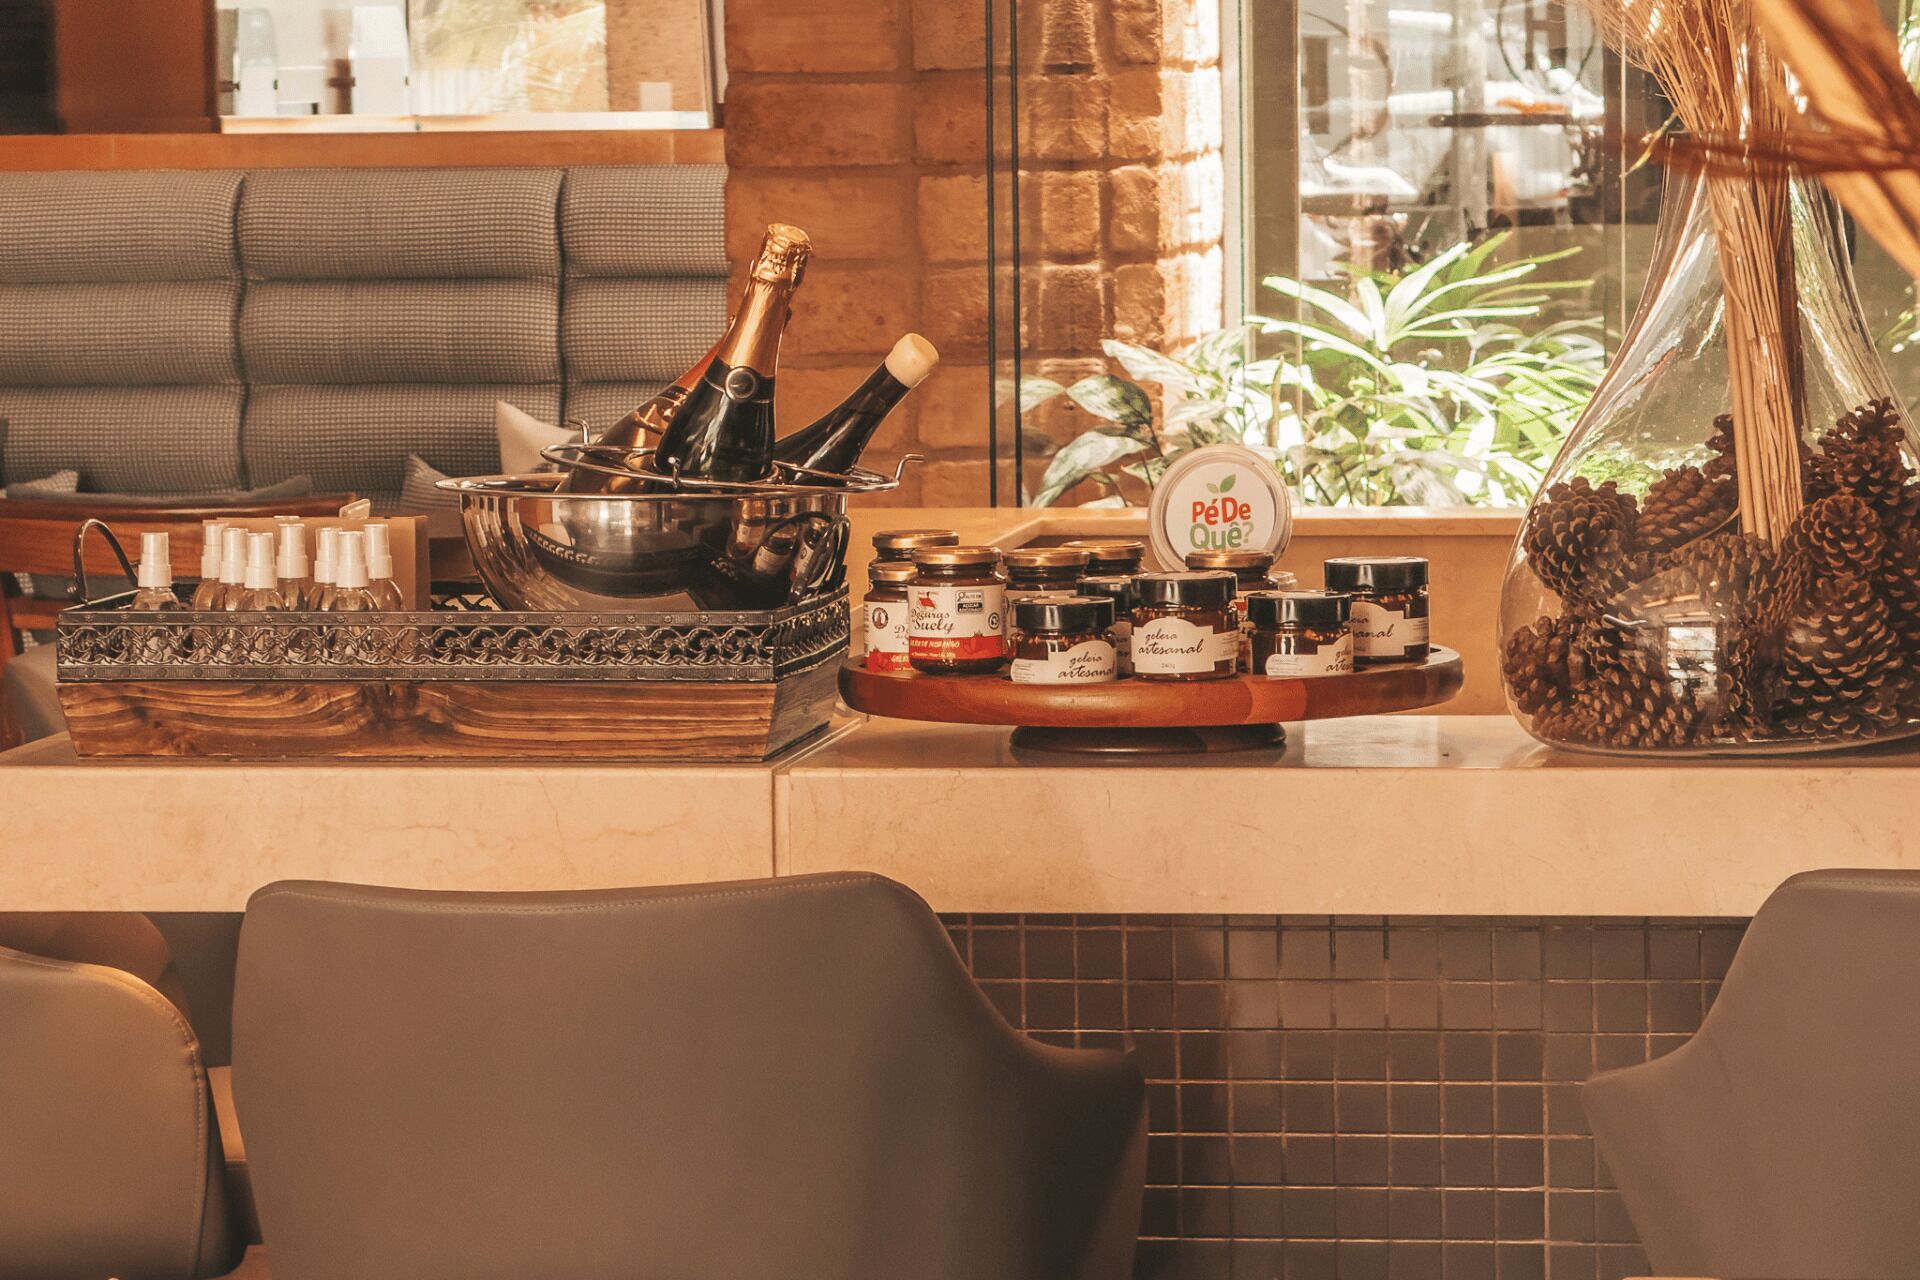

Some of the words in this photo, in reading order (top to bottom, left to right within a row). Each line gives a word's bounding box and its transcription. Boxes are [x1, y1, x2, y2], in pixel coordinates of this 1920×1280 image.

[1190, 521, 1254, 551] Quê?
[914, 618, 954, 635] Suely
[1145, 628, 1177, 645] geleia
[1138, 638, 1204, 656] artesanal
[1069, 651, 1103, 668] geleia
